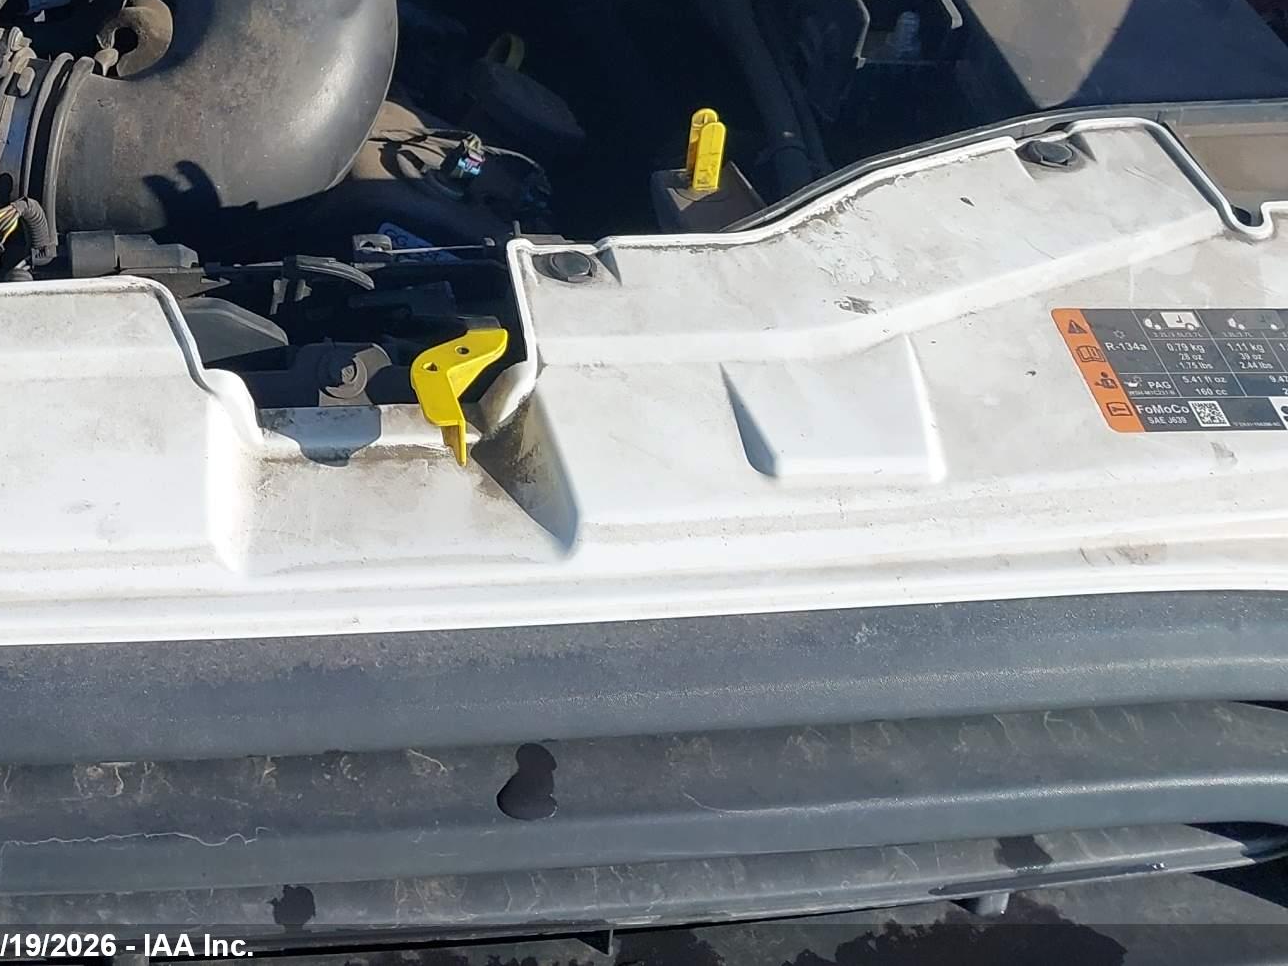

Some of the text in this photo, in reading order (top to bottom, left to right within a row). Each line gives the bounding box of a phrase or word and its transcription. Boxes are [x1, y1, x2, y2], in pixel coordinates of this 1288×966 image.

[1105, 342, 1148, 351] R-134a
[1166, 343, 1206, 354] 0.79 kg
[1227, 343, 1265, 354] 1.11 kg
[1199, 361, 1213, 369] lbs
[1239, 361, 1274, 369] 2.44 lbs
[1182, 375, 1205, 383] 5.41
[1147, 381, 1172, 389] PAG
[1195, 388, 1214, 396] 160
[1136, 404, 1190, 414] FoMoCo
[1147, 416, 1188, 424] SAE J639
